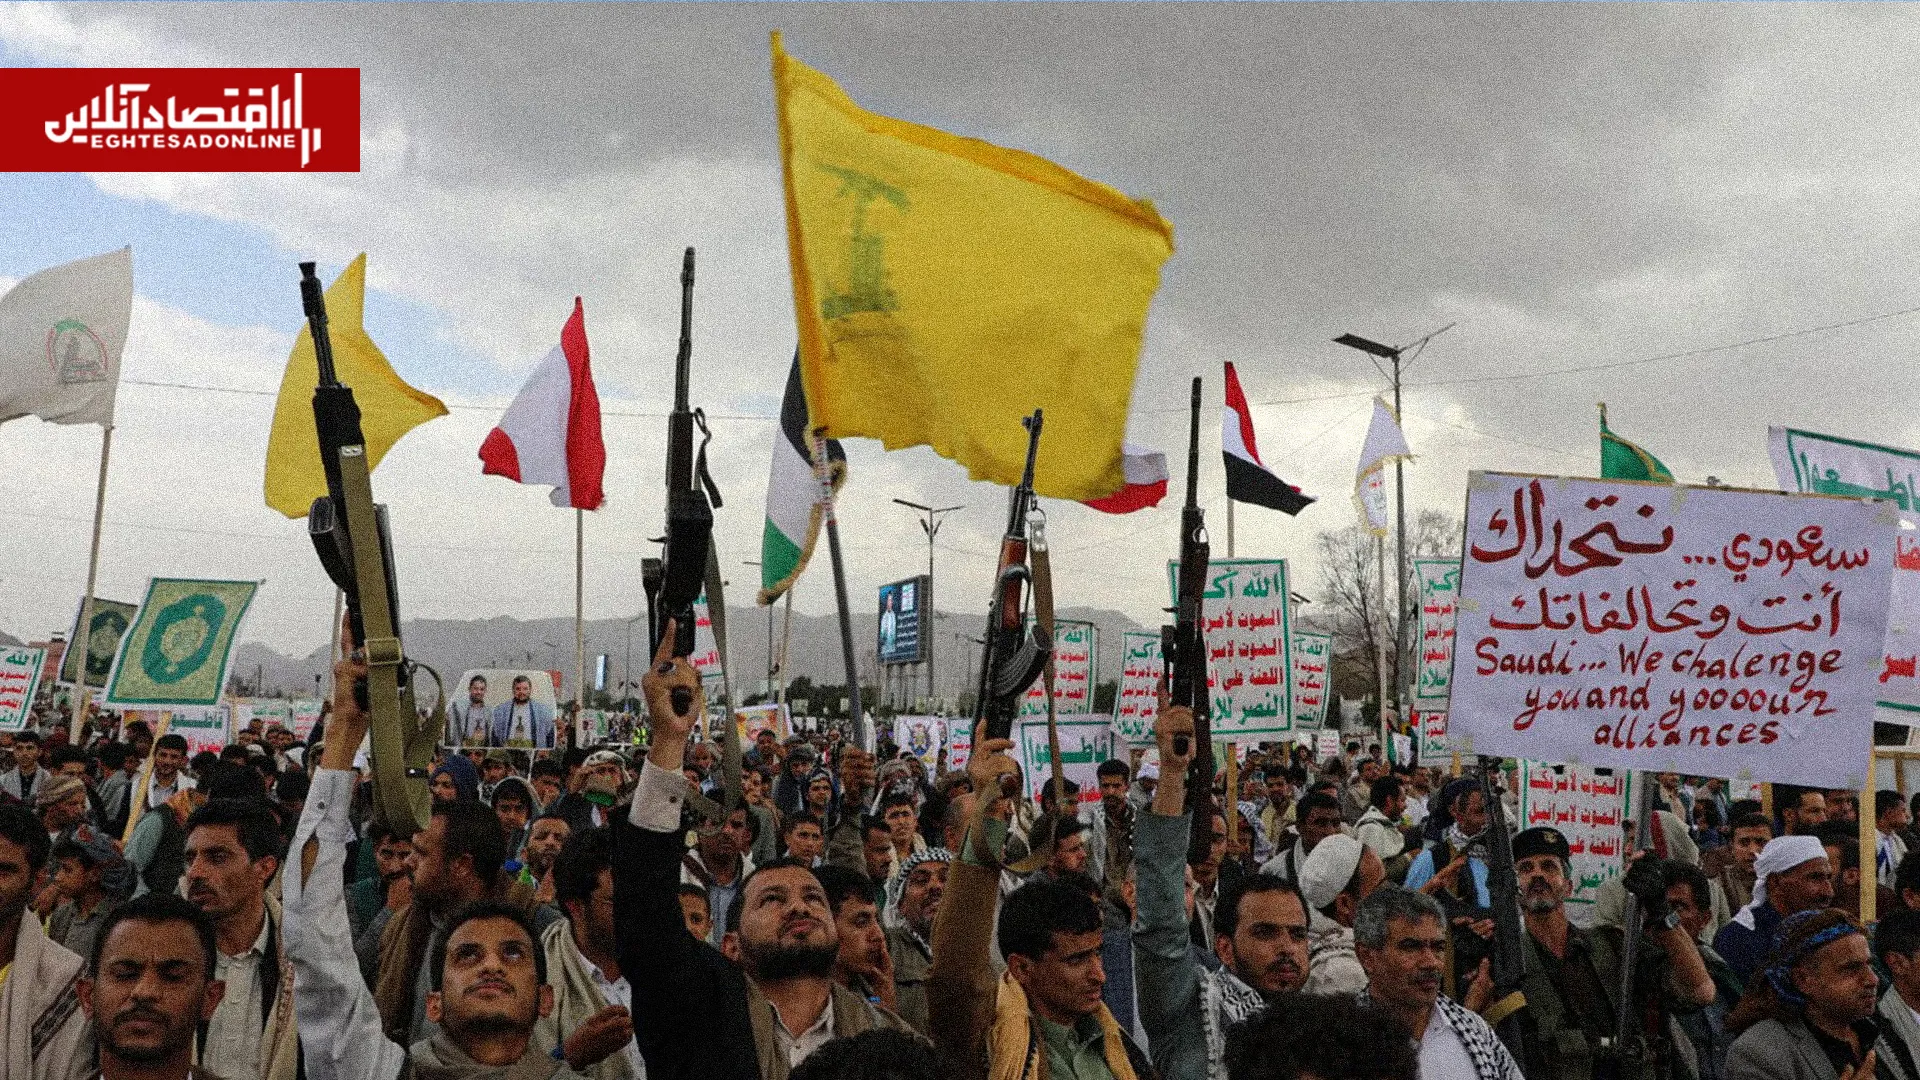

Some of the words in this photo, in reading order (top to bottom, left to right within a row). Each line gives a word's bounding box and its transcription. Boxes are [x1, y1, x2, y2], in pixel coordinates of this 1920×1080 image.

[1470, 479, 1674, 579] نتحداك
[1243, 571, 1280, 597] الله
[1736, 581, 1843, 637] أنت
[1618, 637, 1663, 677] We
[1671, 641, 1843, 693] chalenge
[1238, 692, 1285, 725] النصر
[1594, 716, 1780, 750] alliances
